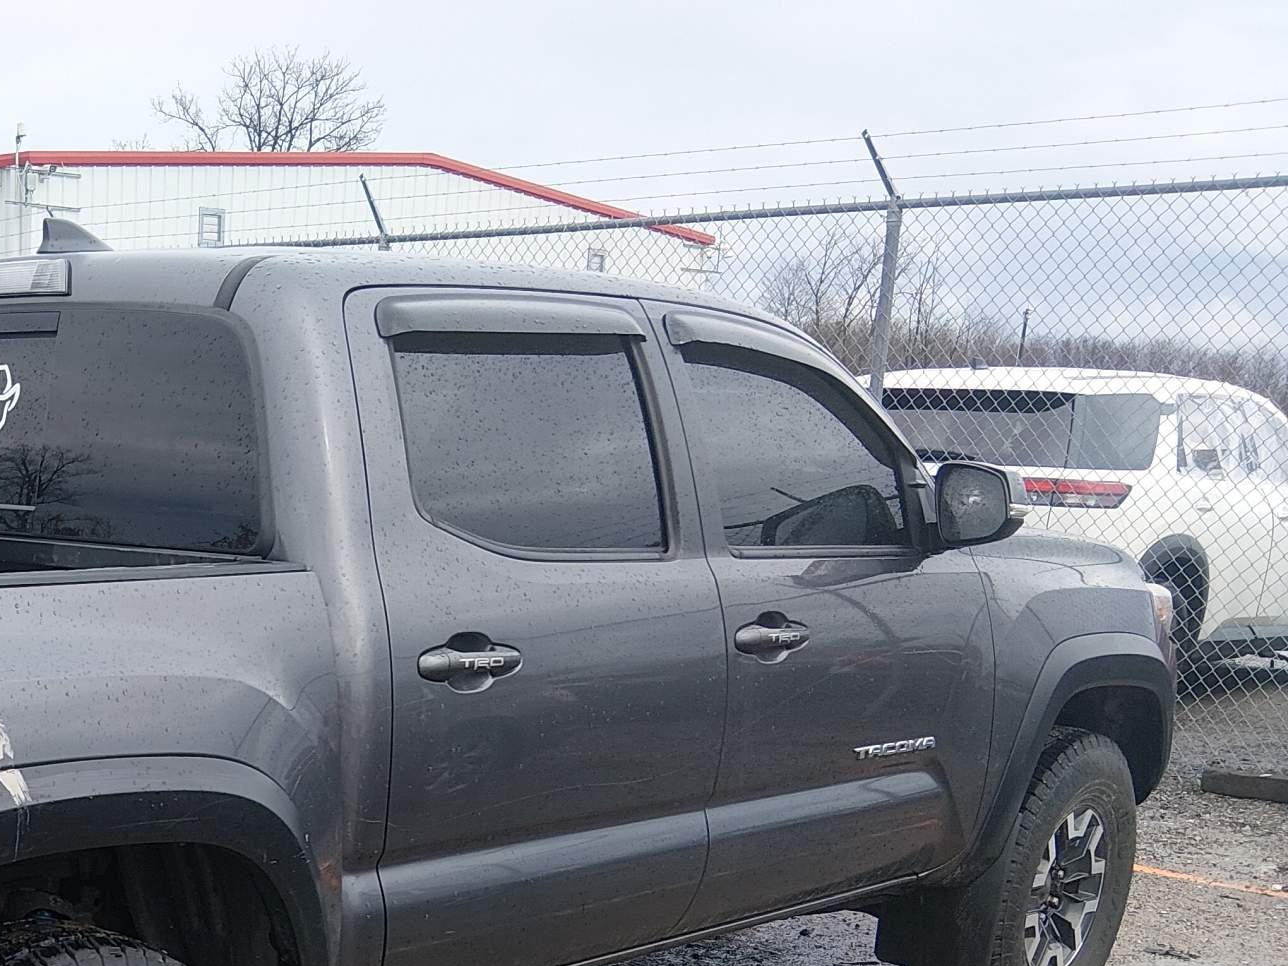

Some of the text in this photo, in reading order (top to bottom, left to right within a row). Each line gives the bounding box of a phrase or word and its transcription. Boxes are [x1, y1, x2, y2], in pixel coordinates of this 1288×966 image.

[768, 632, 800, 644] TRD
[459, 657, 504, 671] TRD
[853, 736, 936, 760] TACOMA
